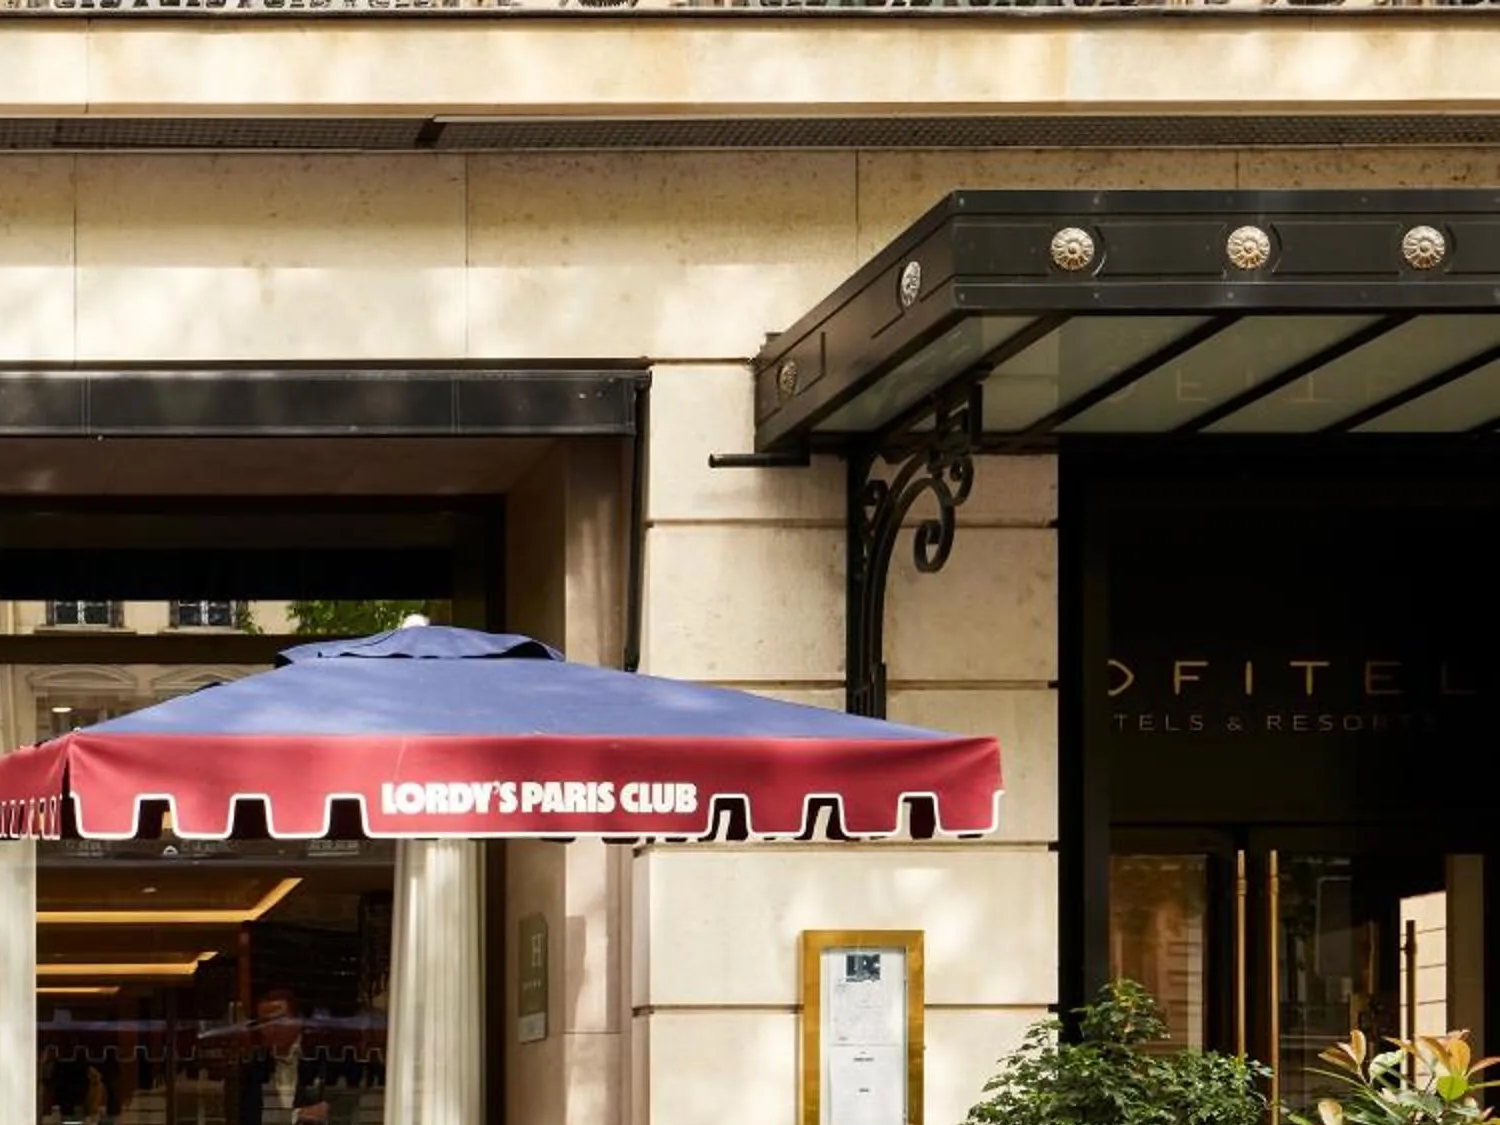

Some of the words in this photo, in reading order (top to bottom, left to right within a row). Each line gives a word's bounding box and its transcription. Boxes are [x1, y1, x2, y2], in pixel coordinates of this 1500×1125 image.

[1107, 658, 1478, 697] OFITEL
[1112, 713, 1205, 732] TELS
[381, 780, 518, 815] LORDY'S
[521, 781, 616, 814] PARIS
[620, 782, 698, 814] CLUB
